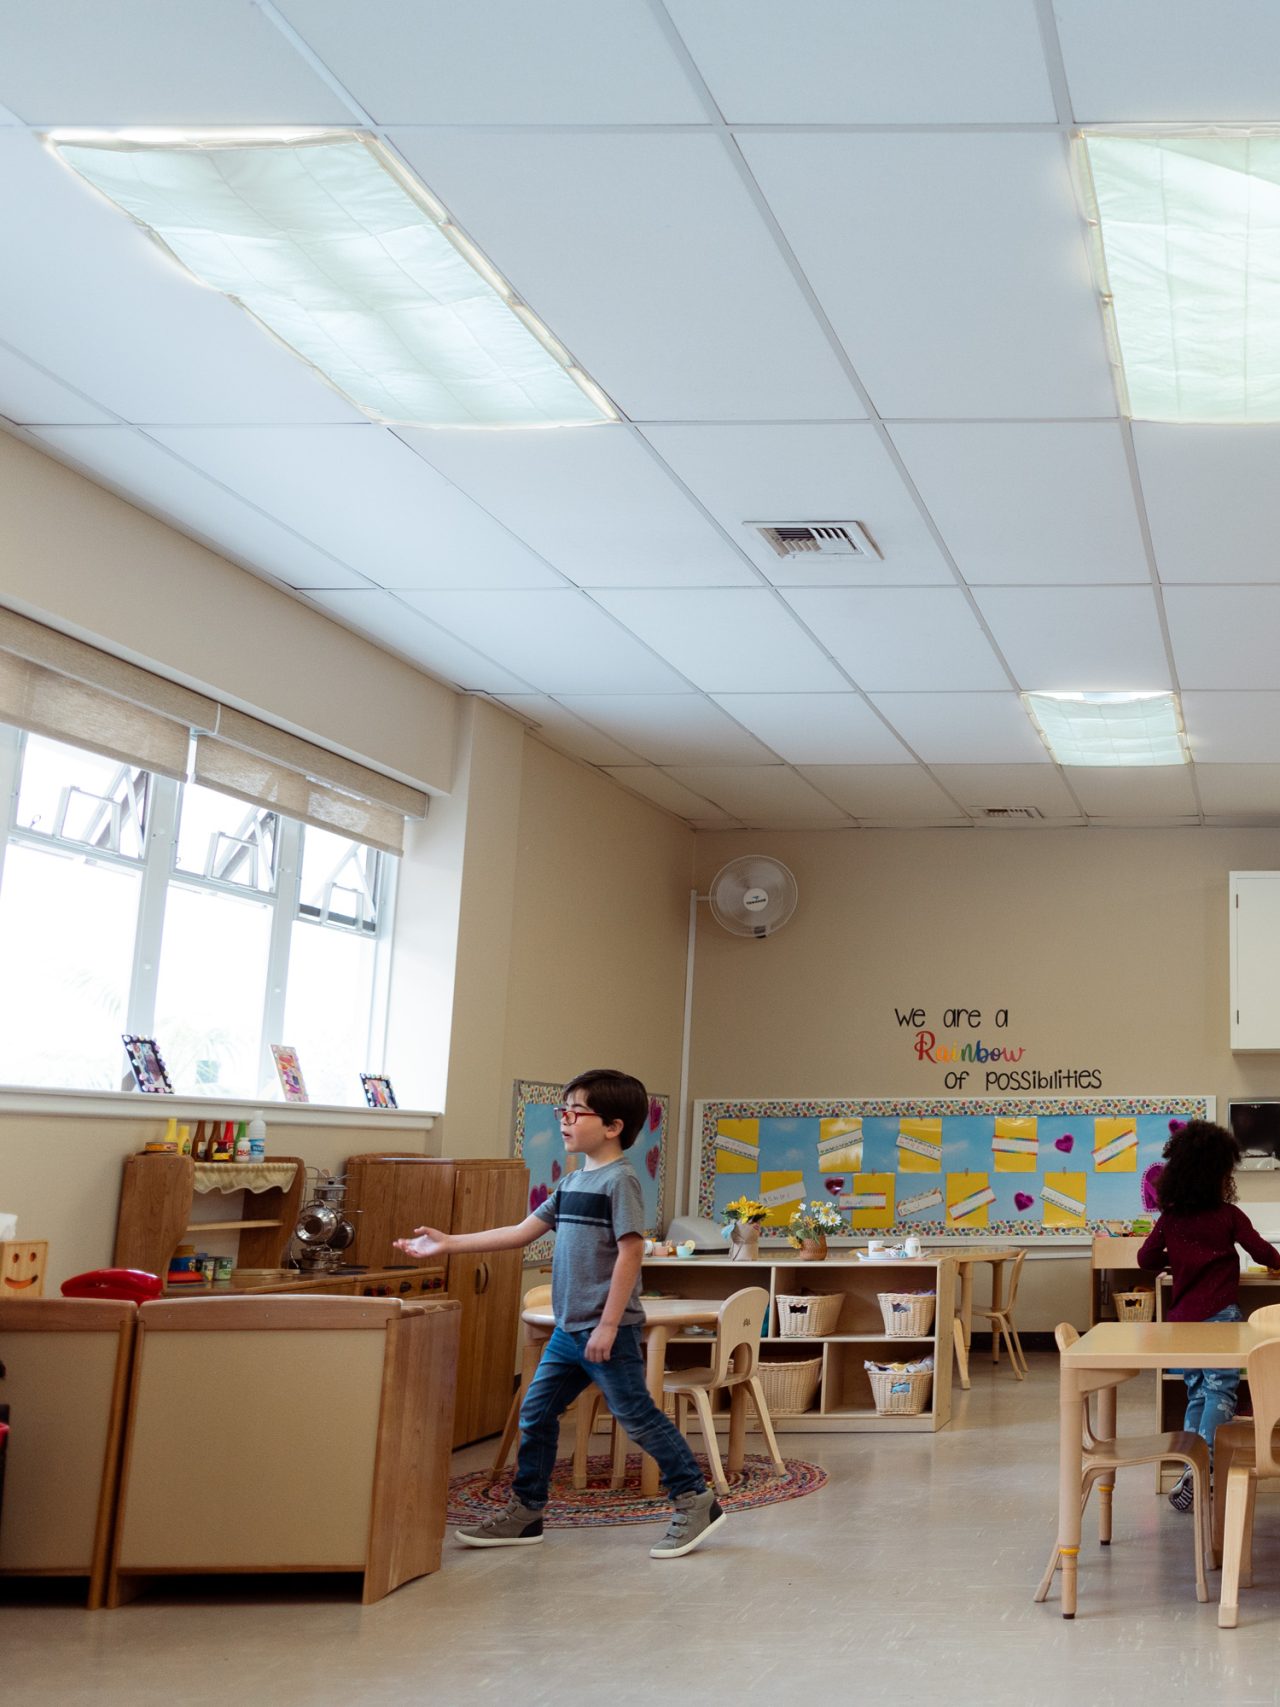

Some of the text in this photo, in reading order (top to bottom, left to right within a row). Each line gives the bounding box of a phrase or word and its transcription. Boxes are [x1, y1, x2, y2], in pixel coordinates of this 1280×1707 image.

[943, 1008, 982, 1028] are
[995, 1009, 1009, 1028] a
[914, 1030, 1026, 1064] Rainbow
[985, 1069, 1102, 1091] possibilities
